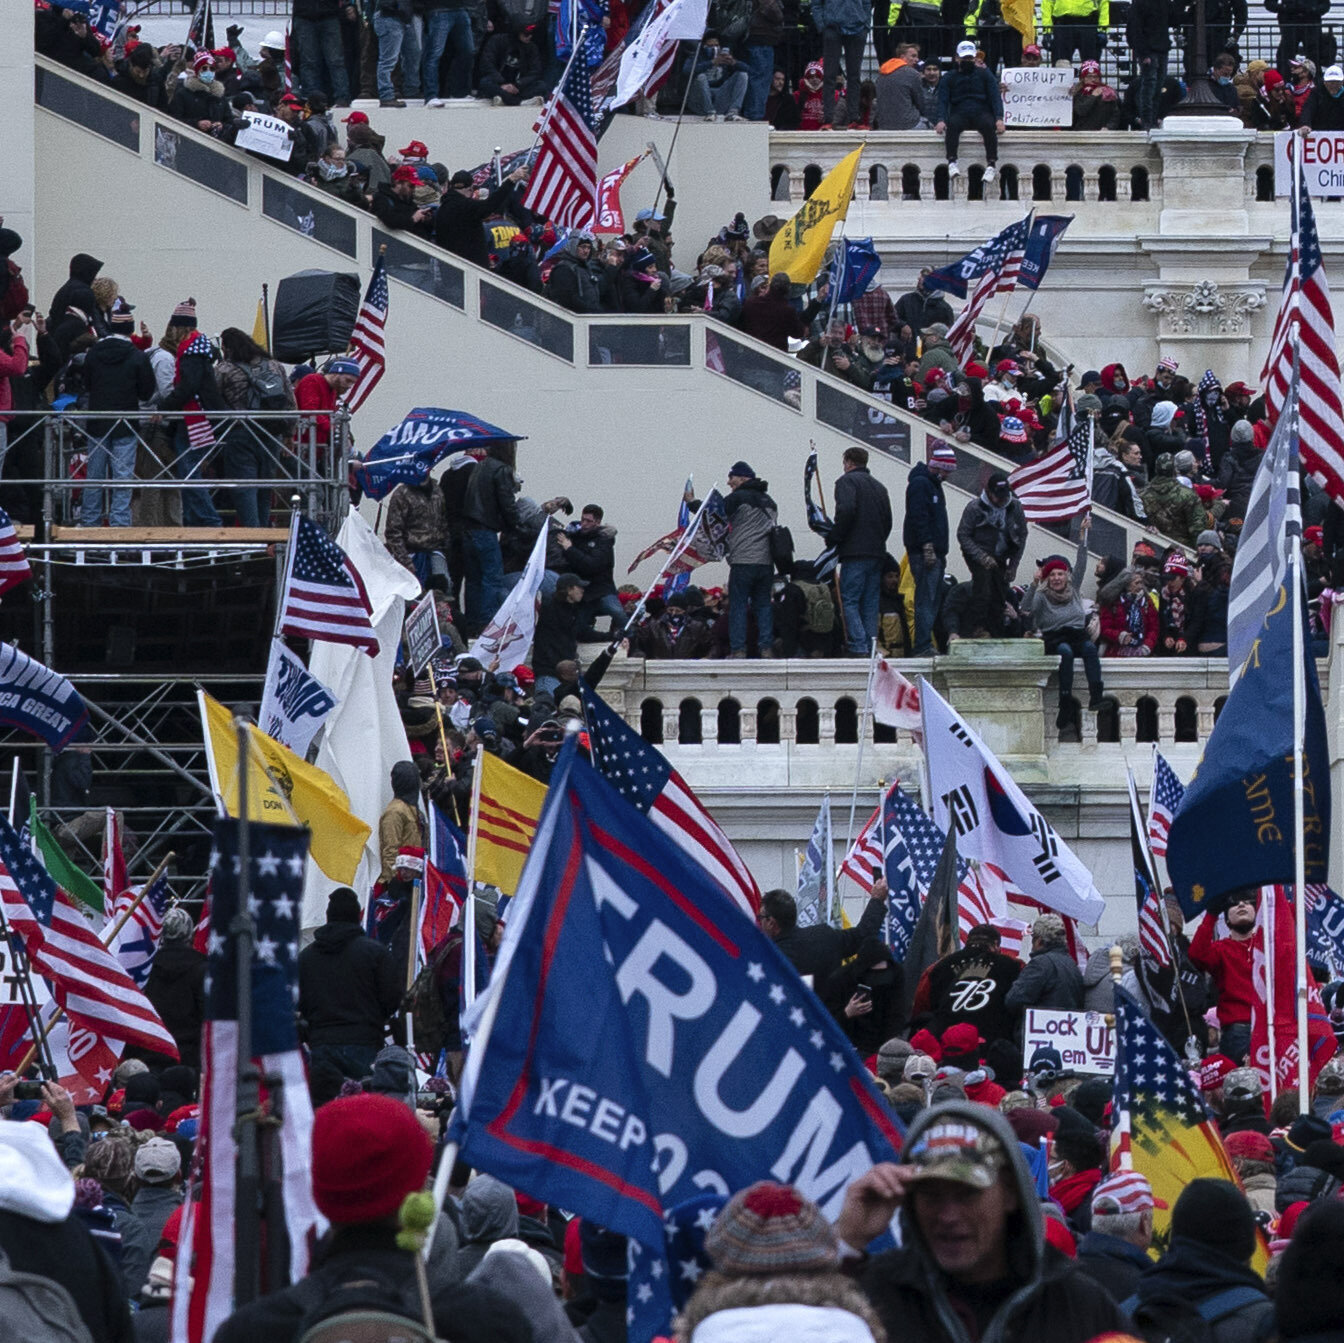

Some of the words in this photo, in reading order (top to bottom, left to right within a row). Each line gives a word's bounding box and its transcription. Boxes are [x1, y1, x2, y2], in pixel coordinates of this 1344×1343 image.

[1004, 71, 1067, 84] CORRUPT
[21, 696, 72, 734] GREAT
[1028, 1009, 1079, 1037] Lock
[533, 1077, 648, 1152] KEEP
